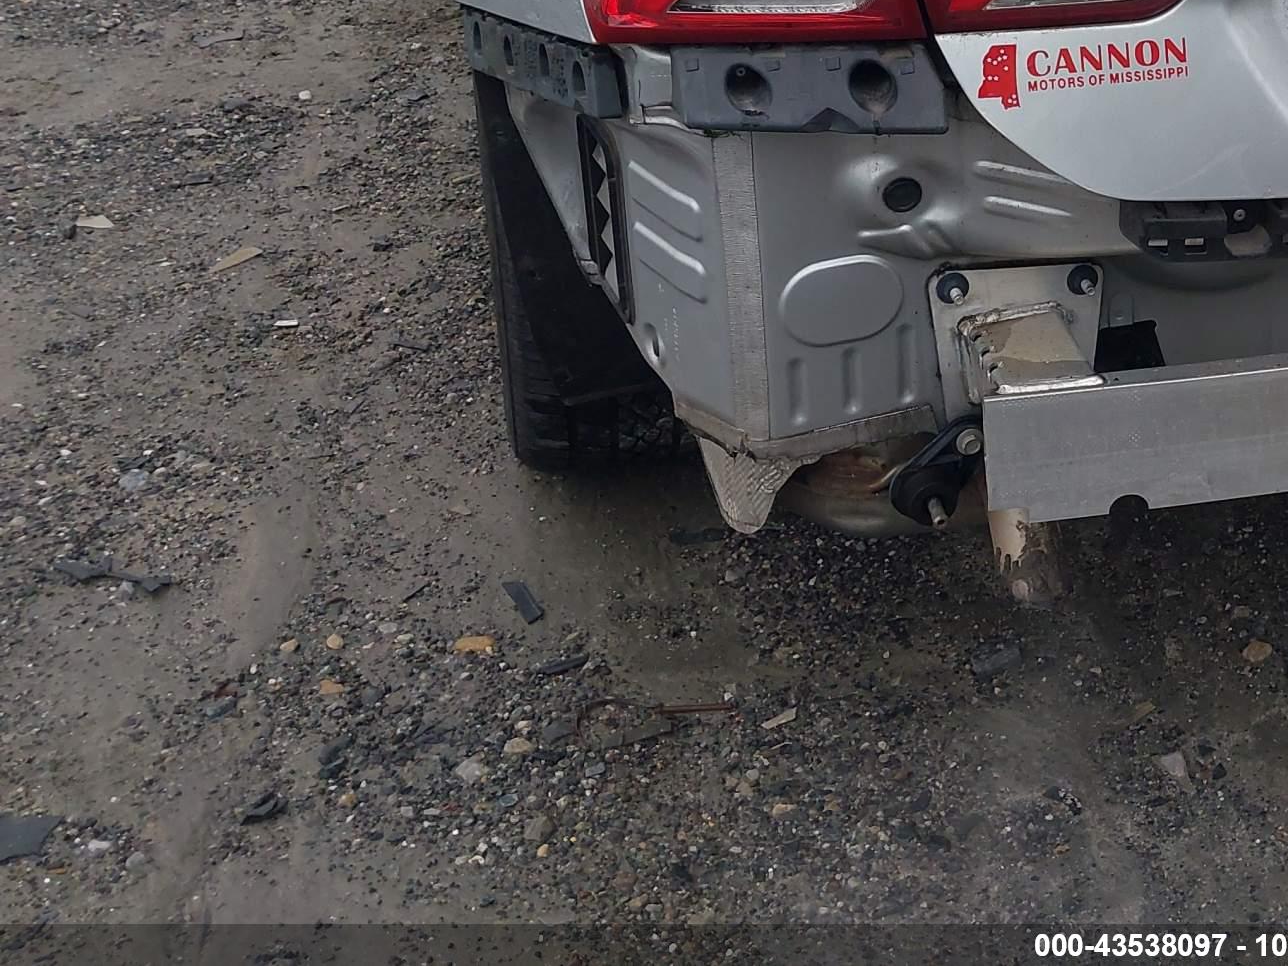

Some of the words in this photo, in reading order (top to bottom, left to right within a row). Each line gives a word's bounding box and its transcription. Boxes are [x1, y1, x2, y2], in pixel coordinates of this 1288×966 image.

[1026, 37, 1188, 77] CANNON
[1027, 75, 1085, 92] MOTORS
[1088, 73, 1106, 86] OF
[1109, 65, 1189, 85] MISSISSIPPI
